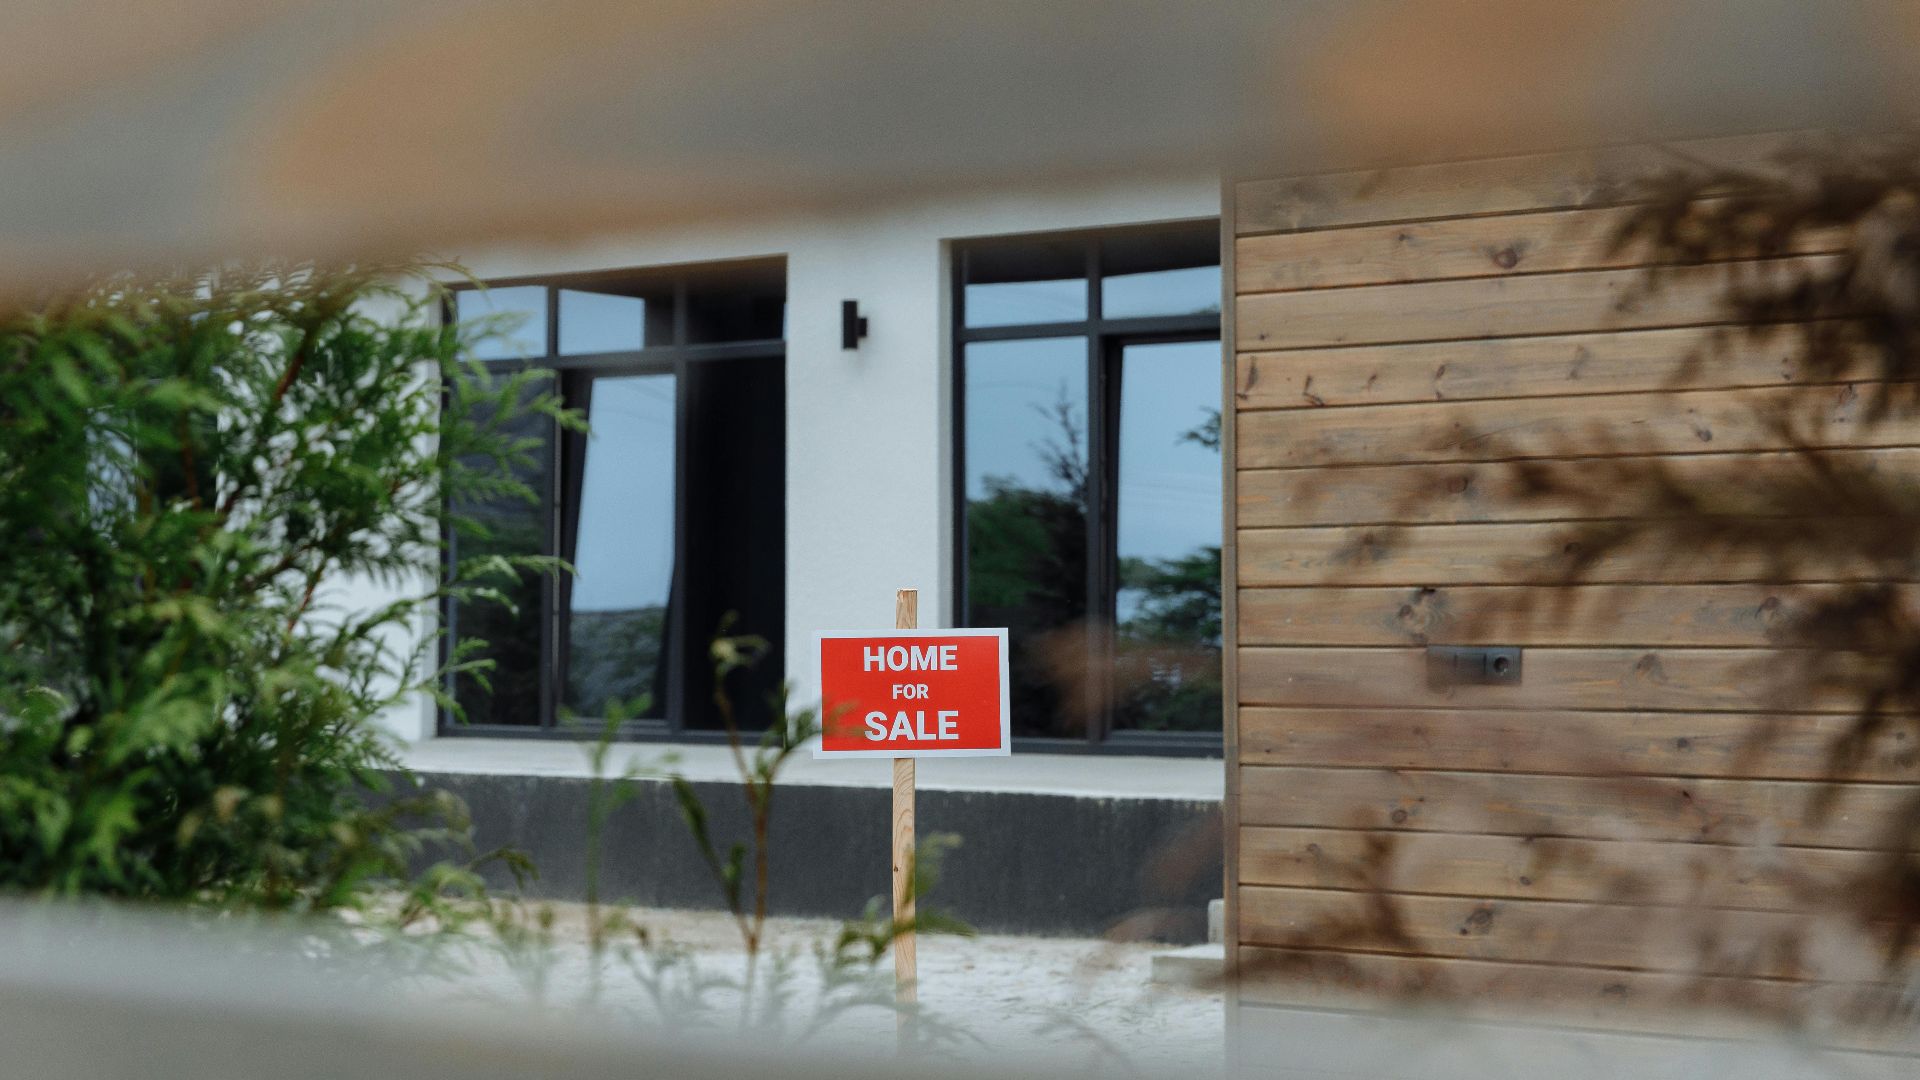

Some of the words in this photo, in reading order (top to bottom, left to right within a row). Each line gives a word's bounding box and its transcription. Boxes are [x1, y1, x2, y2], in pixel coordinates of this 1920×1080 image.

[863, 645, 958, 672] HOME
[892, 683, 929, 700] FOR
[864, 710, 960, 742] SALE
